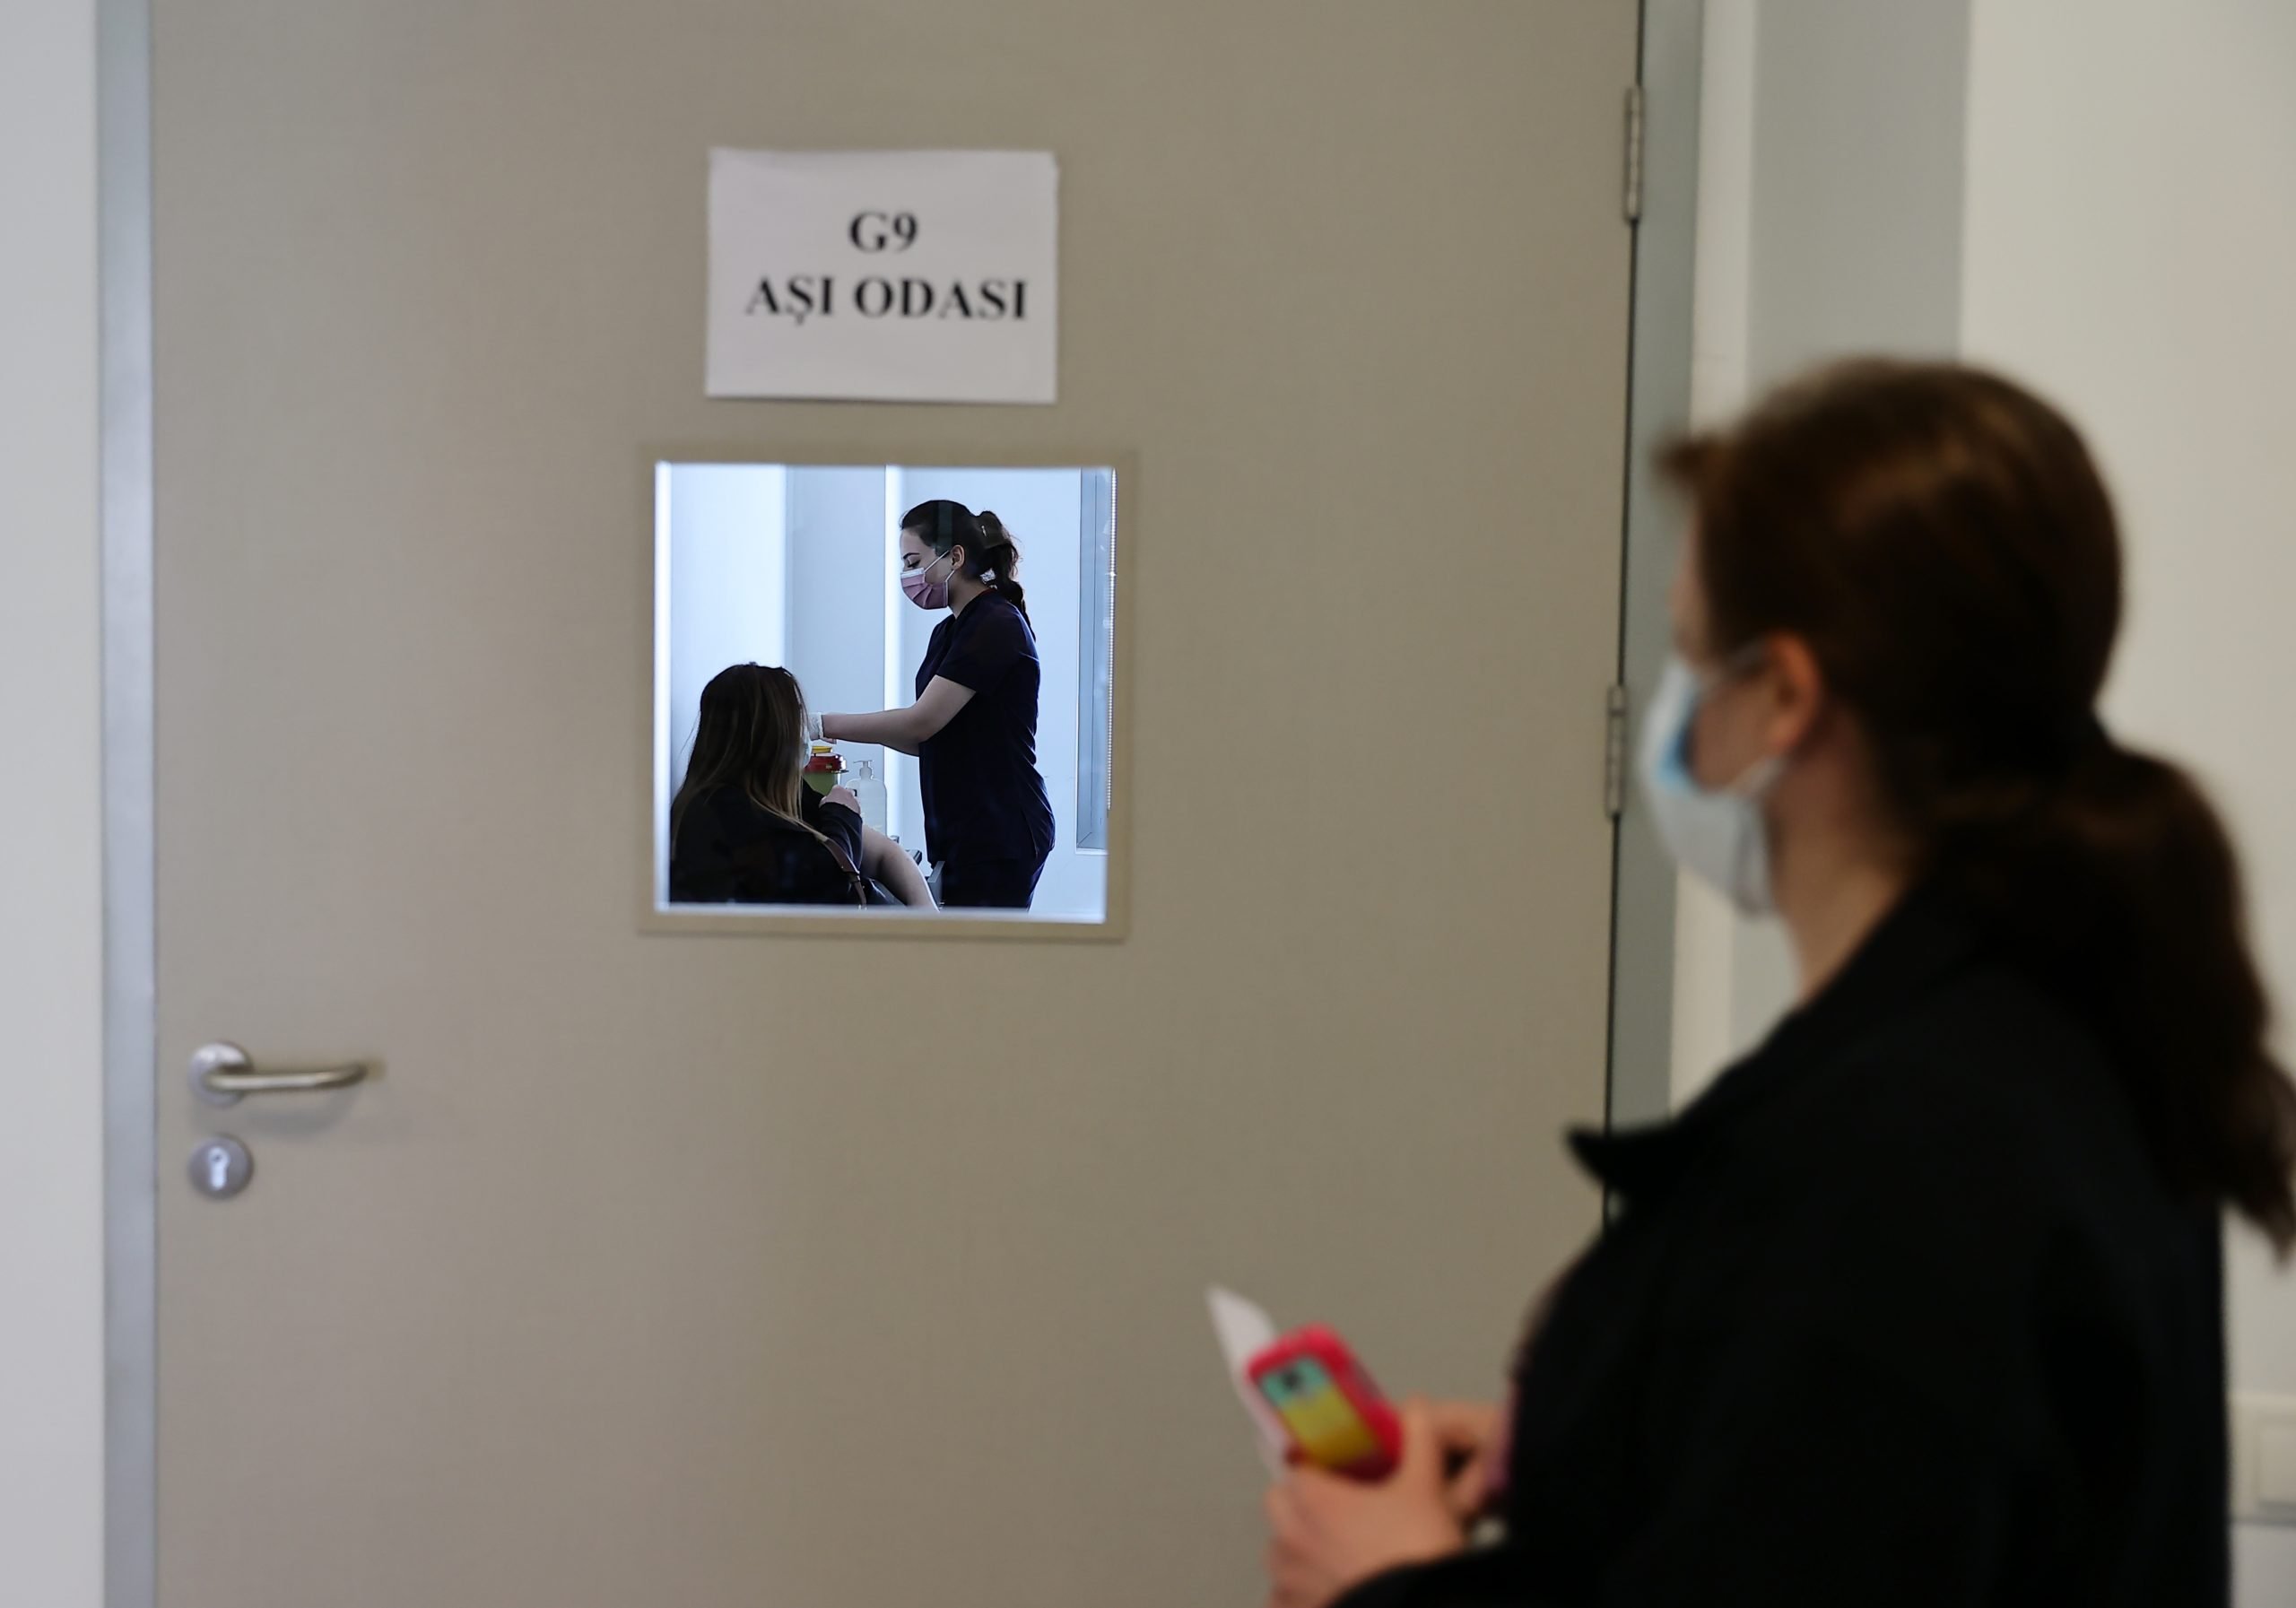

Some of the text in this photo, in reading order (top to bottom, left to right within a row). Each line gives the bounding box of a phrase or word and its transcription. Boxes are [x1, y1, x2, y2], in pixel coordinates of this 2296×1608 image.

[848, 211, 919, 253] G9
[745, 275, 1028, 326] AŞI ODASI
